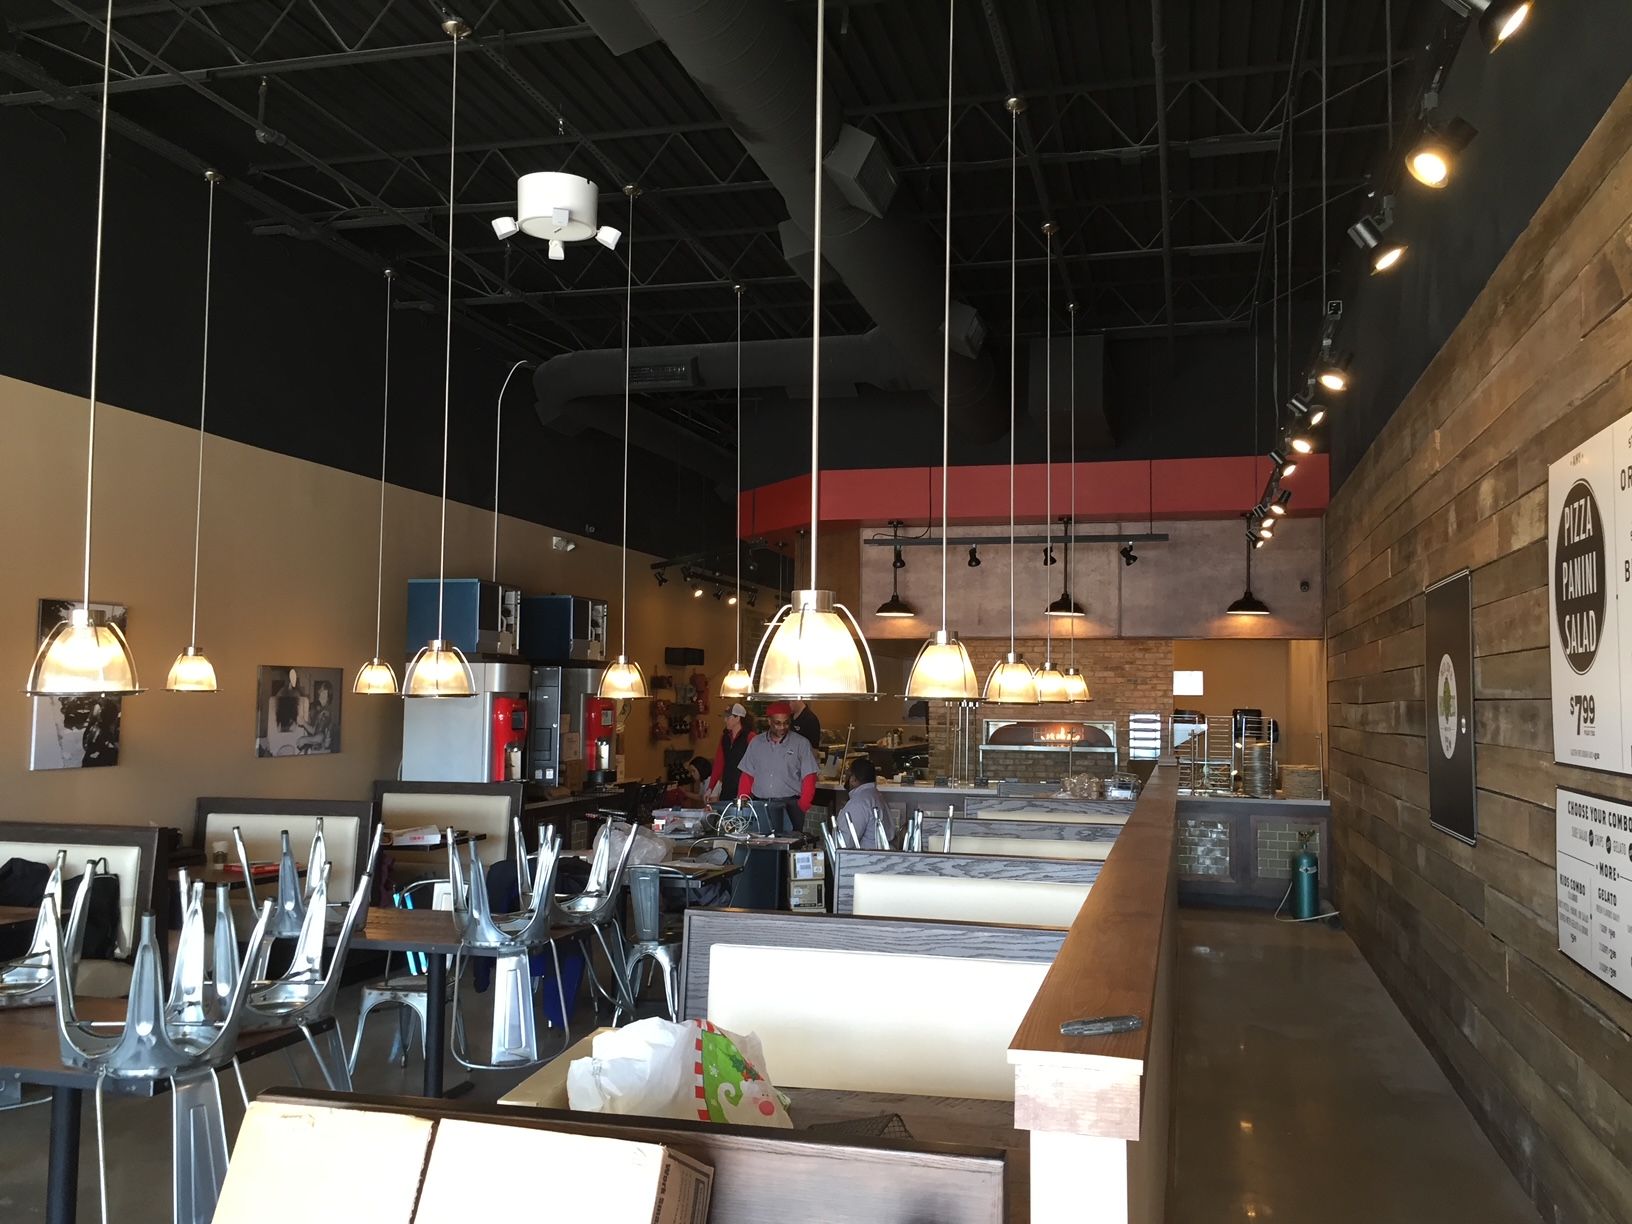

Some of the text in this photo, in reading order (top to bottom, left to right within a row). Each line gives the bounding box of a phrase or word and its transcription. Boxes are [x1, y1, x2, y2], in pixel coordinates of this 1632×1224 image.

[1564, 495, 1593, 547] PIZZA
[1562, 551, 1597, 601] PANINI
[1564, 609, 1597, 655] SALAD
[1567, 800, 1589, 820] CHOOSE
[1590, 806, 1607, 825] YOUR
[1570, 879, 1586, 896] COMBO
[1598, 887, 1617, 907] GELATO
[661, 1163, 671, 1195] Work
